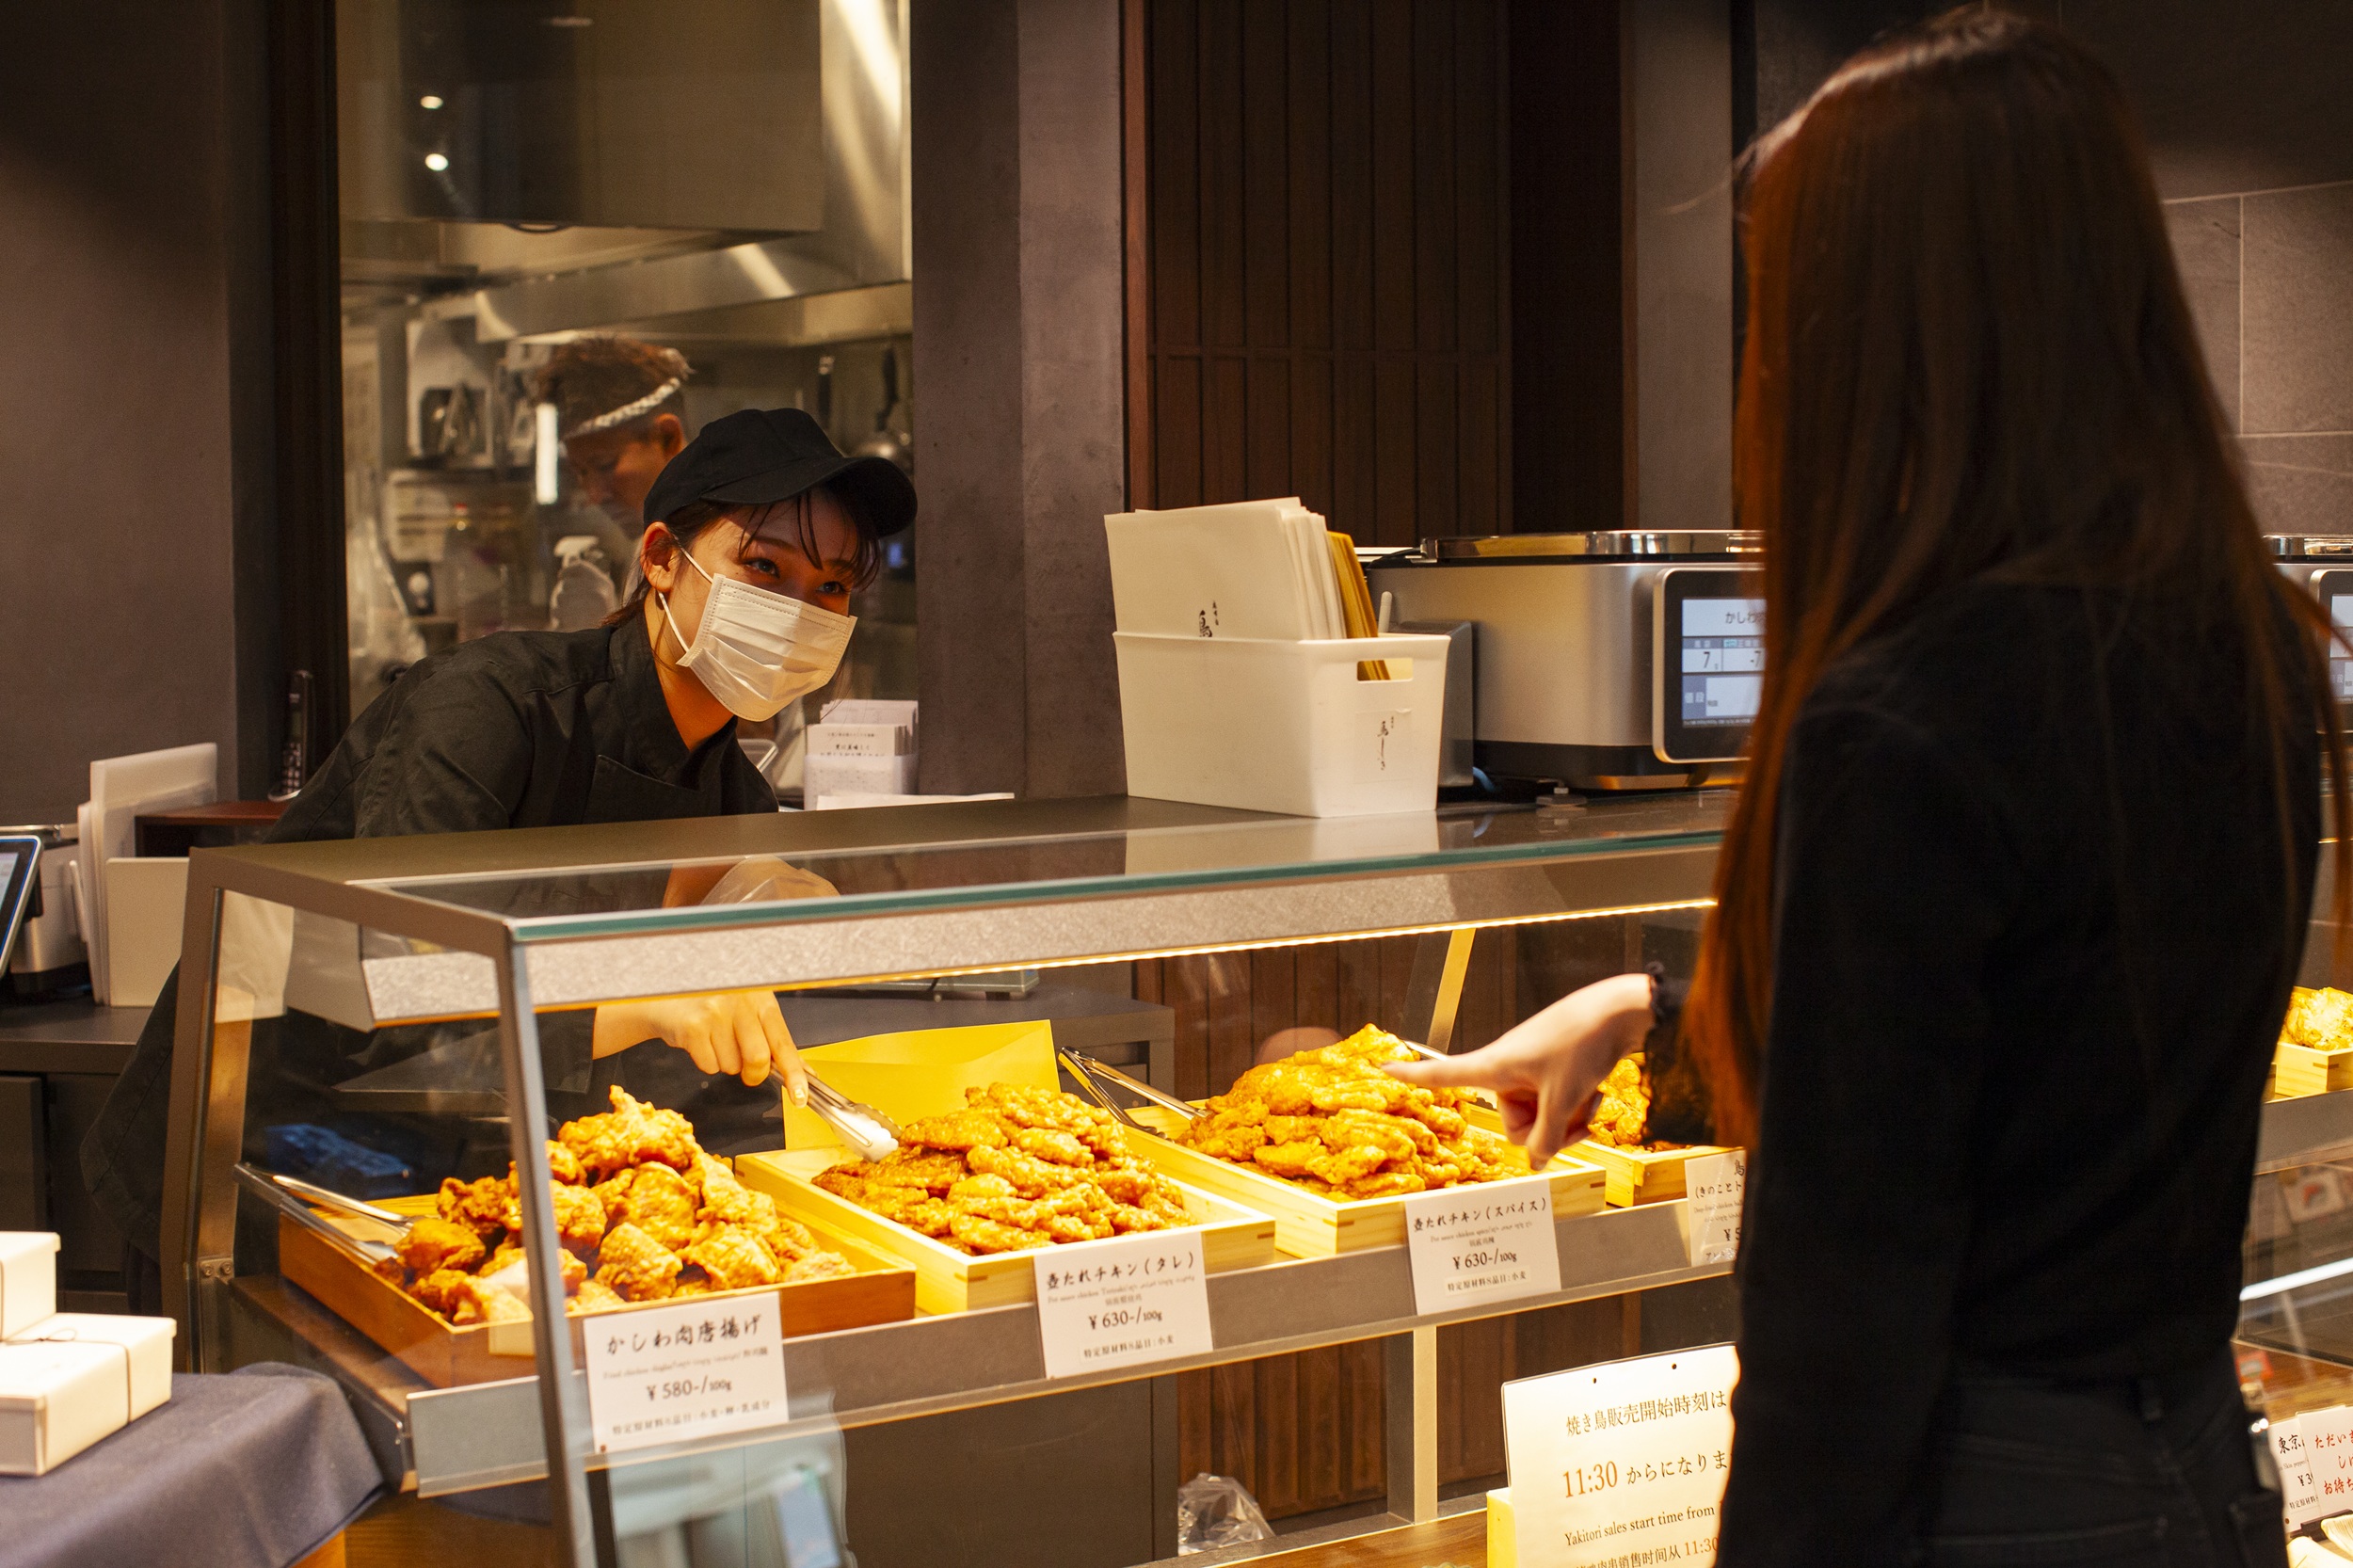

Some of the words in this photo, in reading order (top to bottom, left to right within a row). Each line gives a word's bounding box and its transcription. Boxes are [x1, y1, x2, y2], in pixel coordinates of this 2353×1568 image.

[1704, 651, 1710, 668] 7
[607, 1314, 761, 1355] かしわ肉唐揚げ
[1566, 1390, 1727, 1437] 焼き鳥販売開始時刻は
[2279, 1433, 2305, 1454] 東京
[1562, 1461, 1618, 1498] 11:30
[1626, 1450, 1728, 1485] からになりま
[1564, 1526, 1602, 1546] Yakitori
[1604, 1522, 1627, 1537] sales
[1629, 1516, 1656, 1531] start
[1657, 1511, 1684, 1526] time
[1687, 1506, 1715, 1520] from
[1577, 1544, 1681, 1568] 肉串销售时间从
[1685, 1537, 1718, 1556] 11:30
